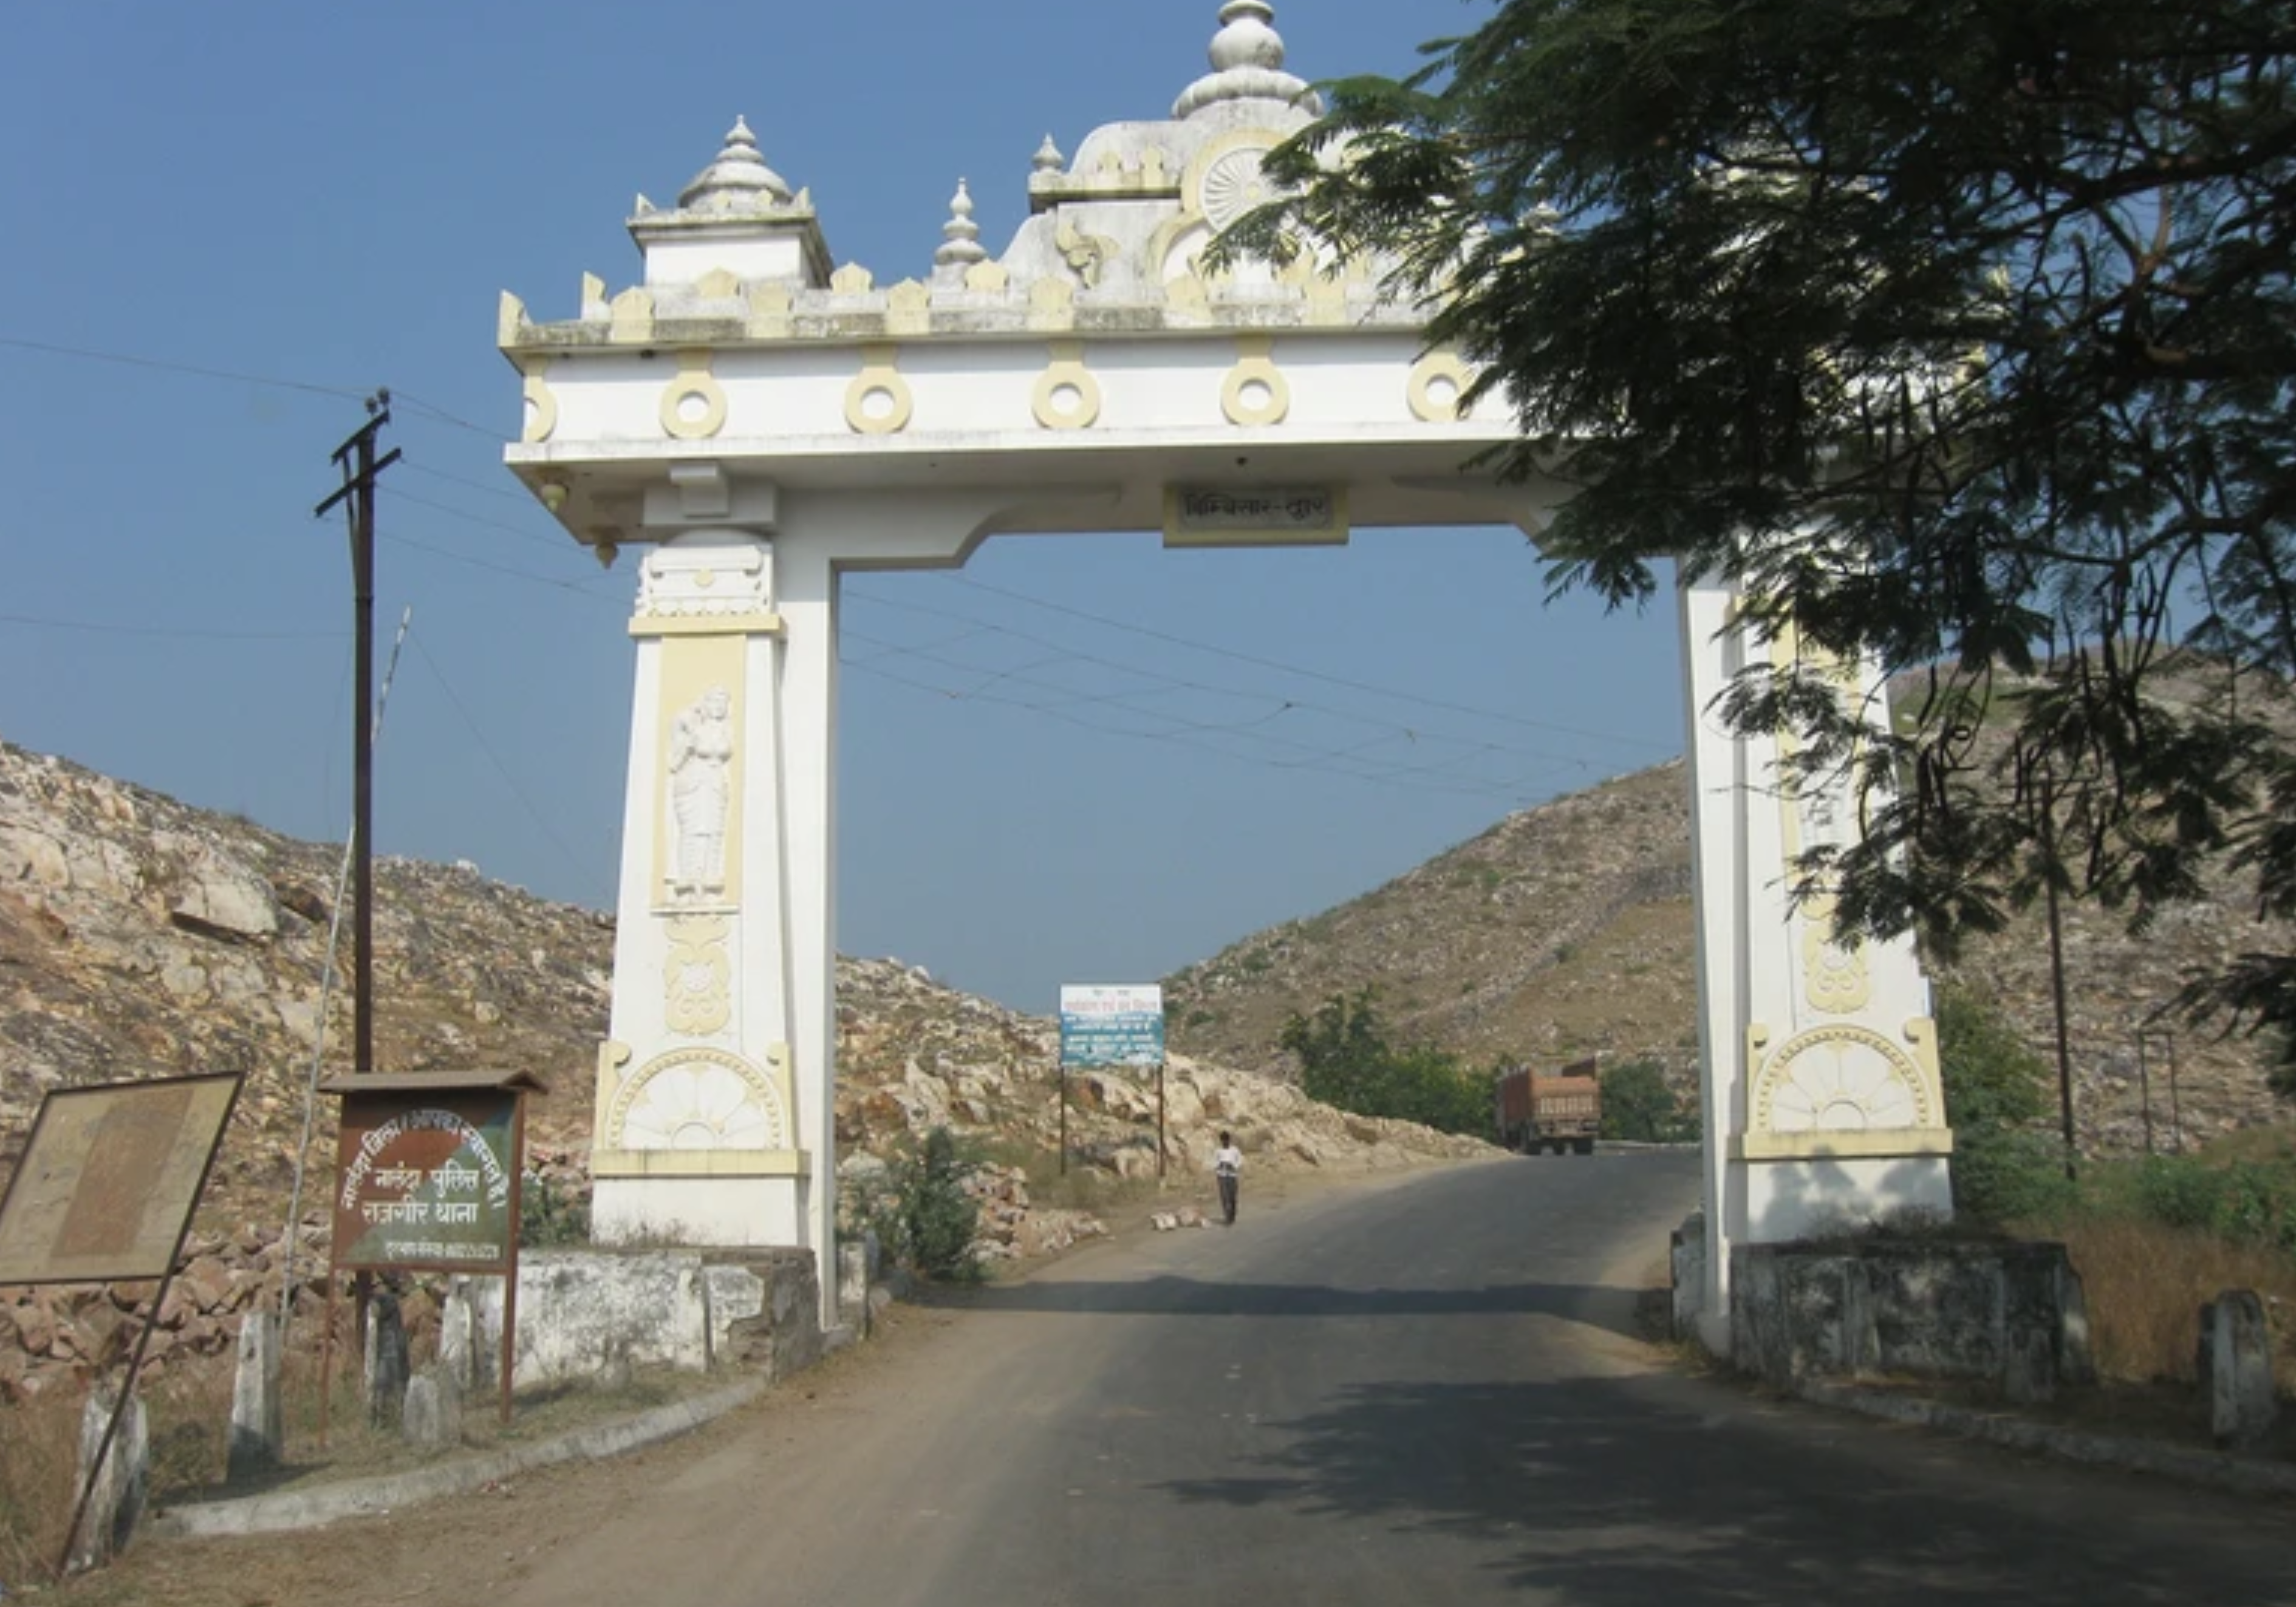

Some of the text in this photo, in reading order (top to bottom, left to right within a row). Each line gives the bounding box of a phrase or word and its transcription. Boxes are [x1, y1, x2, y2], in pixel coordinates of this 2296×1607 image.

[429, 1158, 480, 1198] पुलिस
[362, 1193, 480, 1224] राजगीर थाना
